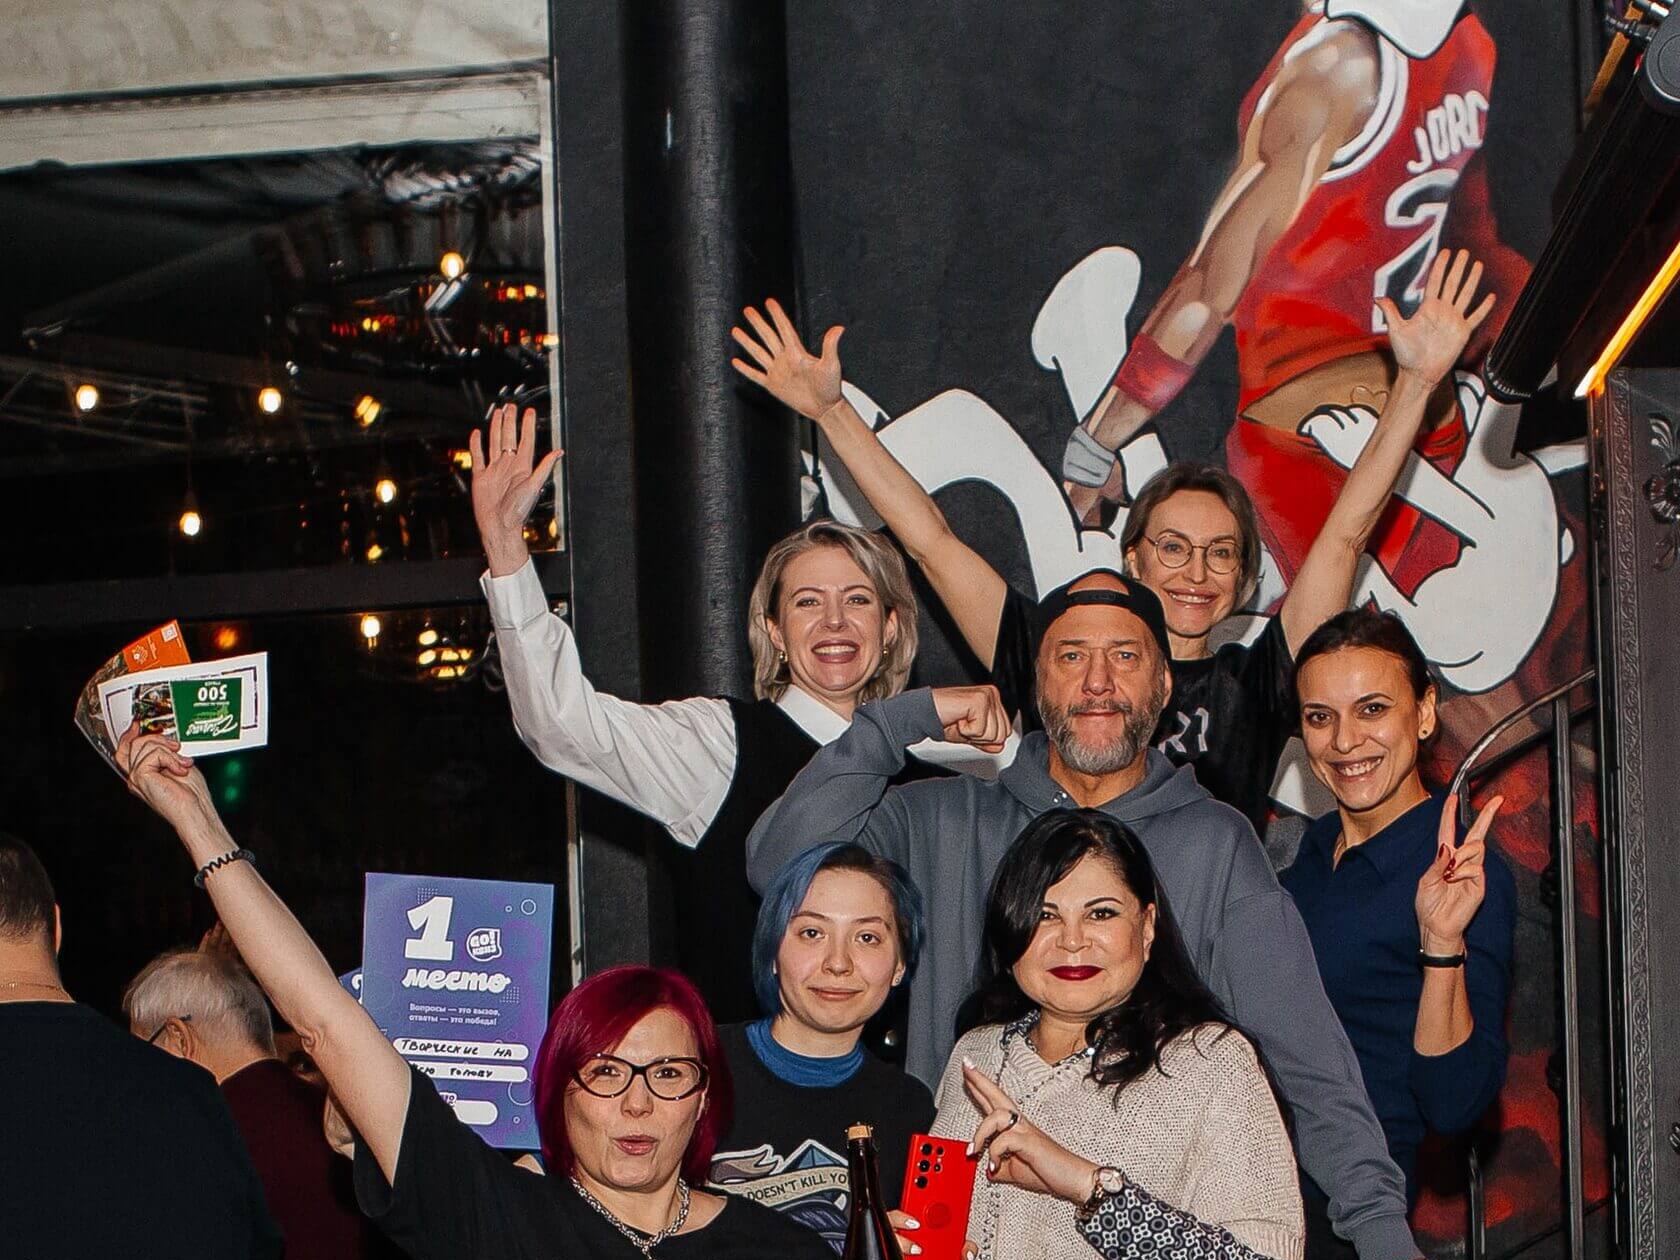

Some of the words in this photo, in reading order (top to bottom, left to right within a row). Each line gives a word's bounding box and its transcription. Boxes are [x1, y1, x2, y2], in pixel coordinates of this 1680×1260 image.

[198, 684, 228, 701] 500
[404, 895, 454, 961] 1
[401, 967, 512, 993] место
[409, 1003, 446, 1013] Вопросы
[494, 1047, 512, 1057] НА
[747, 1179, 798, 1201] DOESN'T
[800, 1175, 827, 1189] KILL
[830, 1172, 848, 1184] YO
